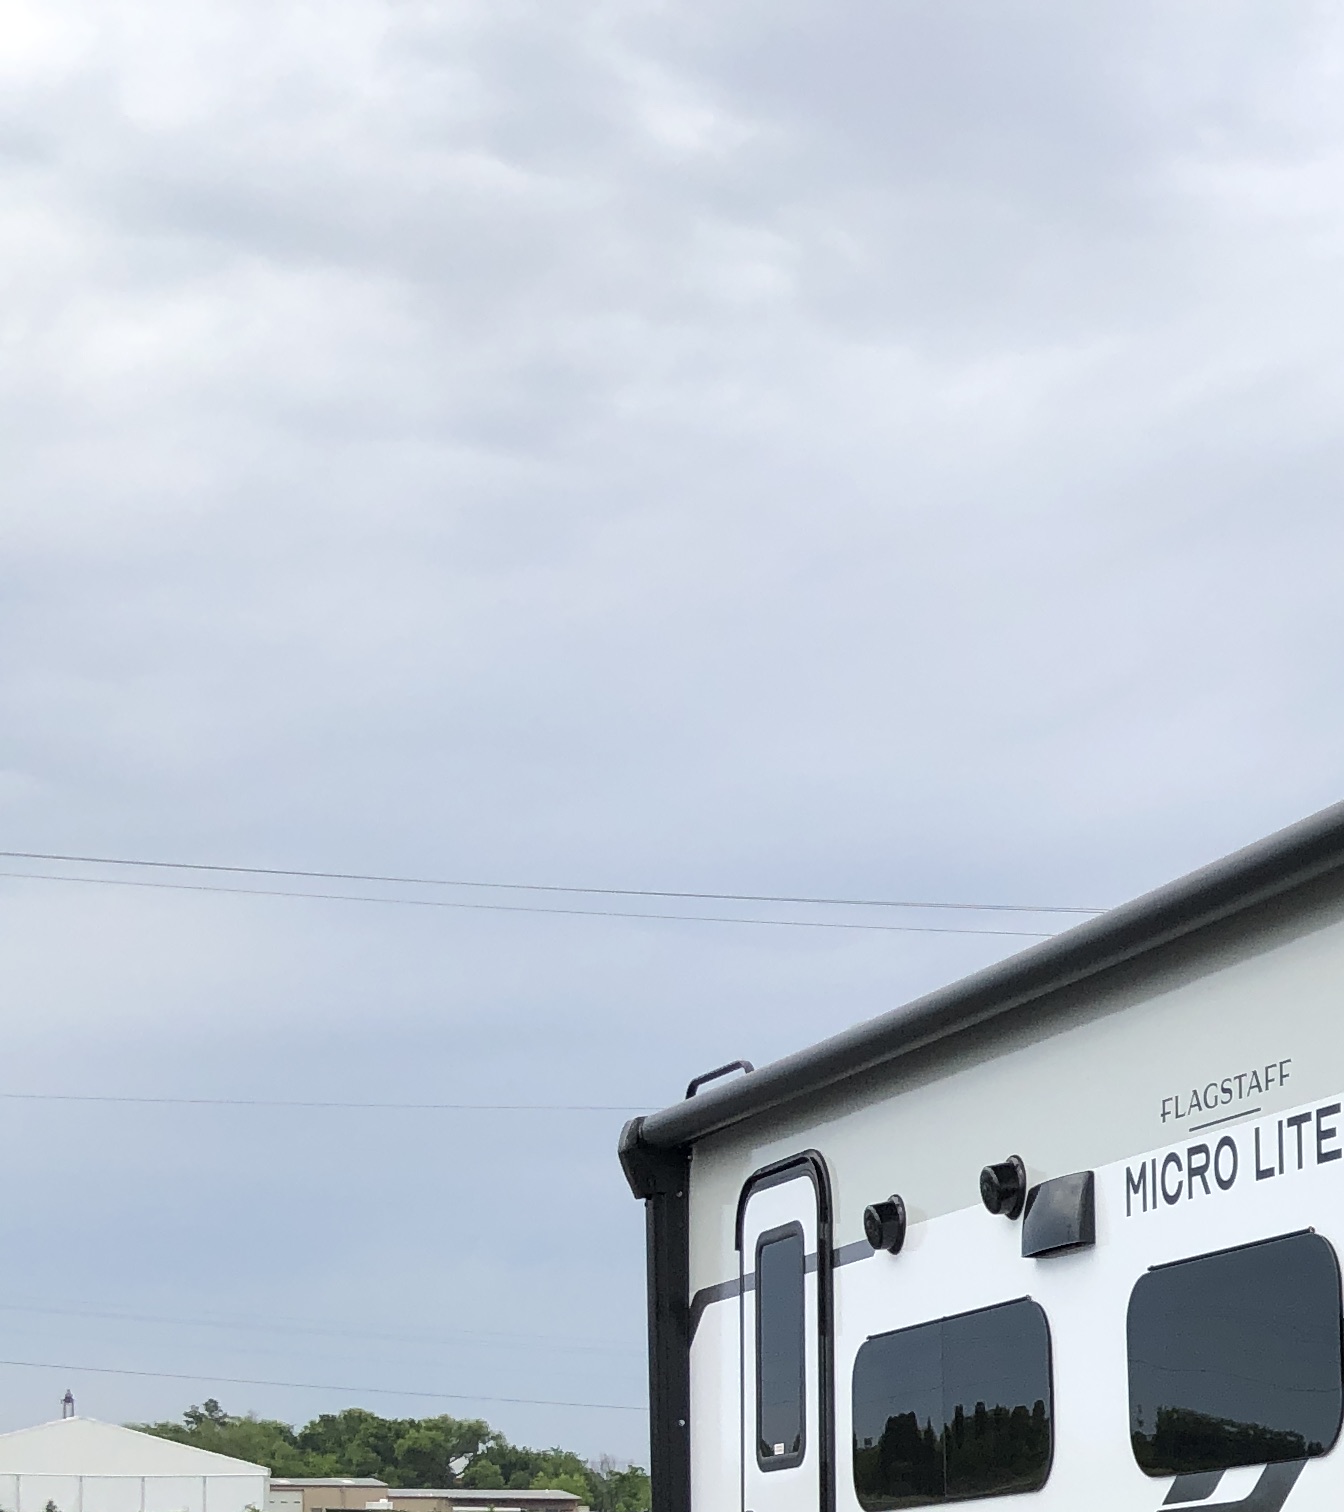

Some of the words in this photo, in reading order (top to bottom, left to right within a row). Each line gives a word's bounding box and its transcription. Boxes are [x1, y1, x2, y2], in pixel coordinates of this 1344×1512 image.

[1160, 1058, 1292, 1124] FLAGSTAFF
[1125, 1134, 1239, 1218] MICRO
[1253, 1101, 1343, 1182] LITE
